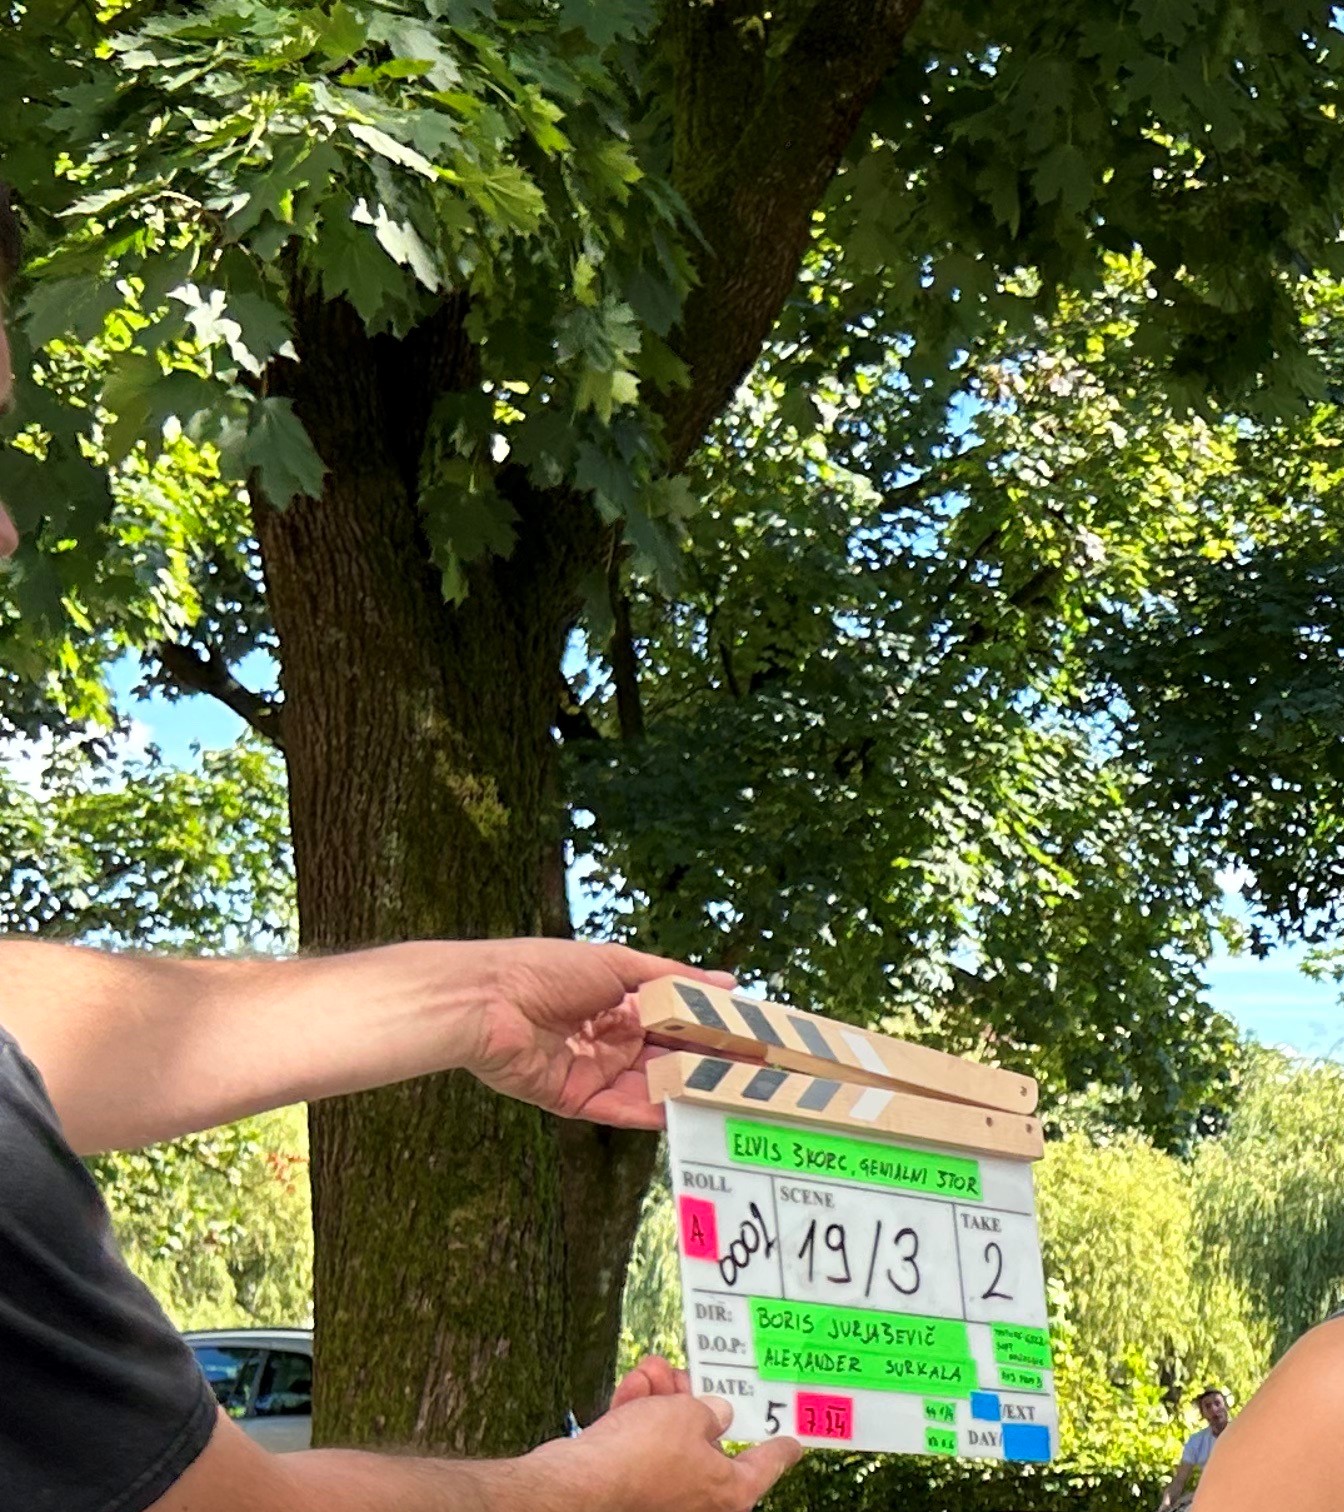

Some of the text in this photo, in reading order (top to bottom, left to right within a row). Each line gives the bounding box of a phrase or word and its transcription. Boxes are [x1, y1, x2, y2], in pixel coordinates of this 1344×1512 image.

[734, 1133, 783, 1162] ELVIS
[682, 1171, 732, 1193] ROLL
[780, 1185, 835, 1209] SCENE
[961, 1213, 1002, 1233] TAKE
[798, 1218, 921, 1298] 19/3
[980, 1241, 1014, 1301] 2
[695, 1302, 733, 1323] DIR:
[756, 1306, 816, 1334] BORIS
[697, 1333, 748, 1355] D.O.P:
[763, 1346, 863, 1374] ALEXANDER
[702, 1376, 755, 1397] DATE:
[764, 1399, 788, 1436] 5
